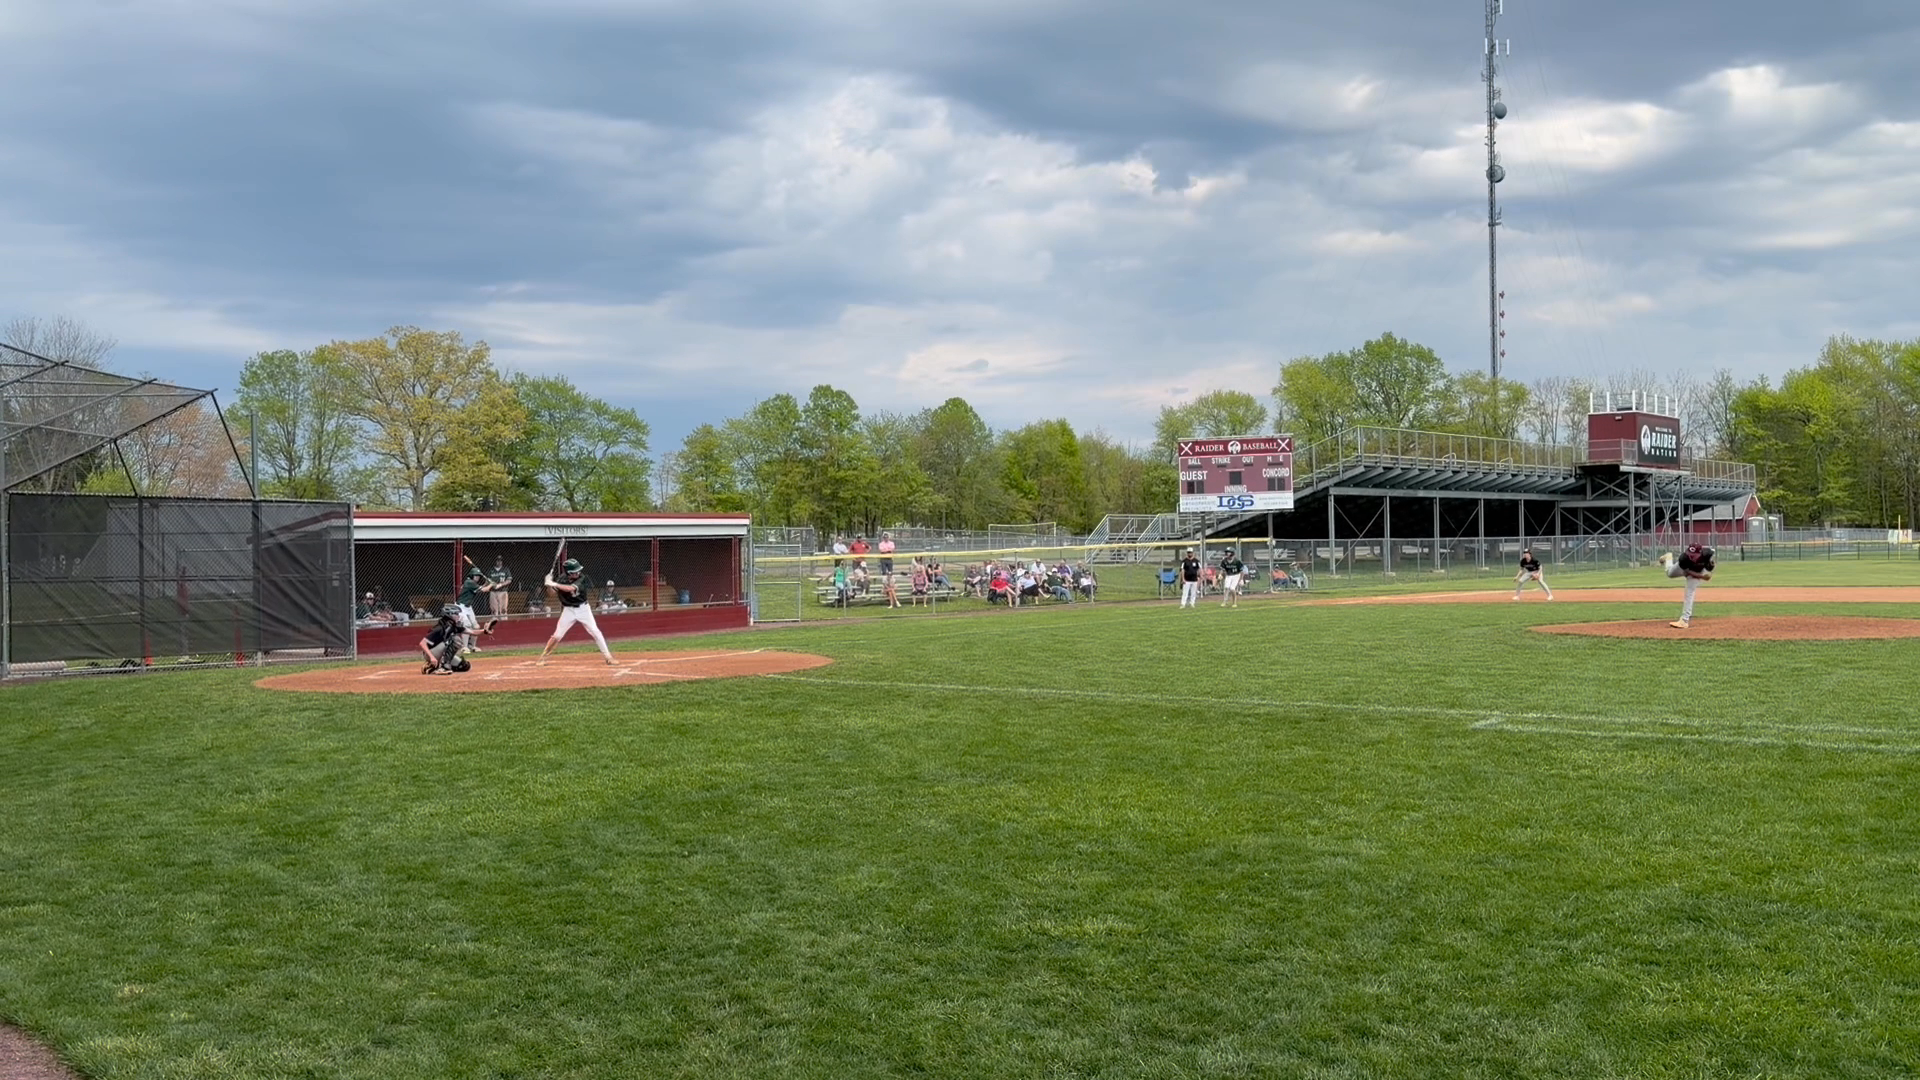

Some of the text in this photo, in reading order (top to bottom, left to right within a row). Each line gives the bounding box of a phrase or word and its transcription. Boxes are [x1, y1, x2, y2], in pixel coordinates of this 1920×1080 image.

[1651, 432, 1677, 449] RAIDER
[1195, 441, 1278, 452] RAIDER BASEBALL
[1651, 448, 1677, 457] NATION
[1181, 468, 1290, 480] GUEST CONCORD
[1224, 485, 1247, 493] INNING
[547, 526, 586, 534] VISITORS
